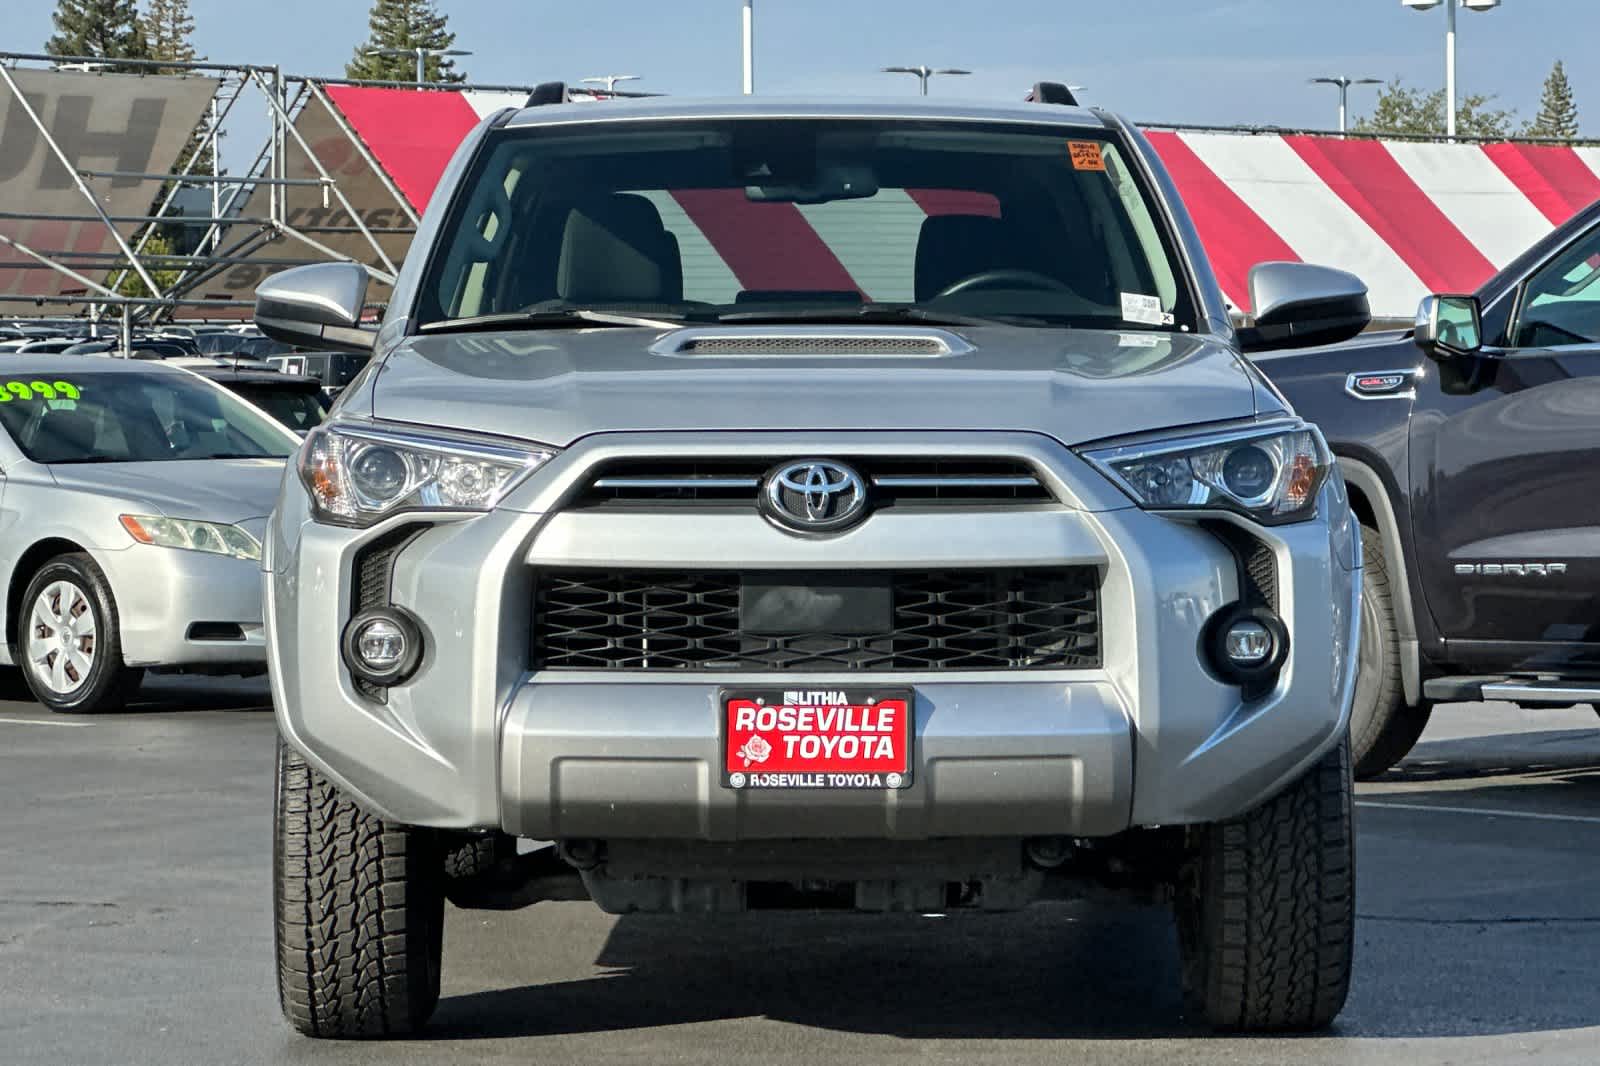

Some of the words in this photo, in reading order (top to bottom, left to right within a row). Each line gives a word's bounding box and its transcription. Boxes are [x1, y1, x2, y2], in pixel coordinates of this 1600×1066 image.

[1454, 563, 1568, 576] SIERRA
[798, 691, 848, 706] LITHIA
[735, 707, 896, 732] ROSEVILLE
[782, 735, 895, 759] TOYOTA
[750, 773, 825, 786] ROSEVILLE
[827, 773, 881, 786] TOYOTA
